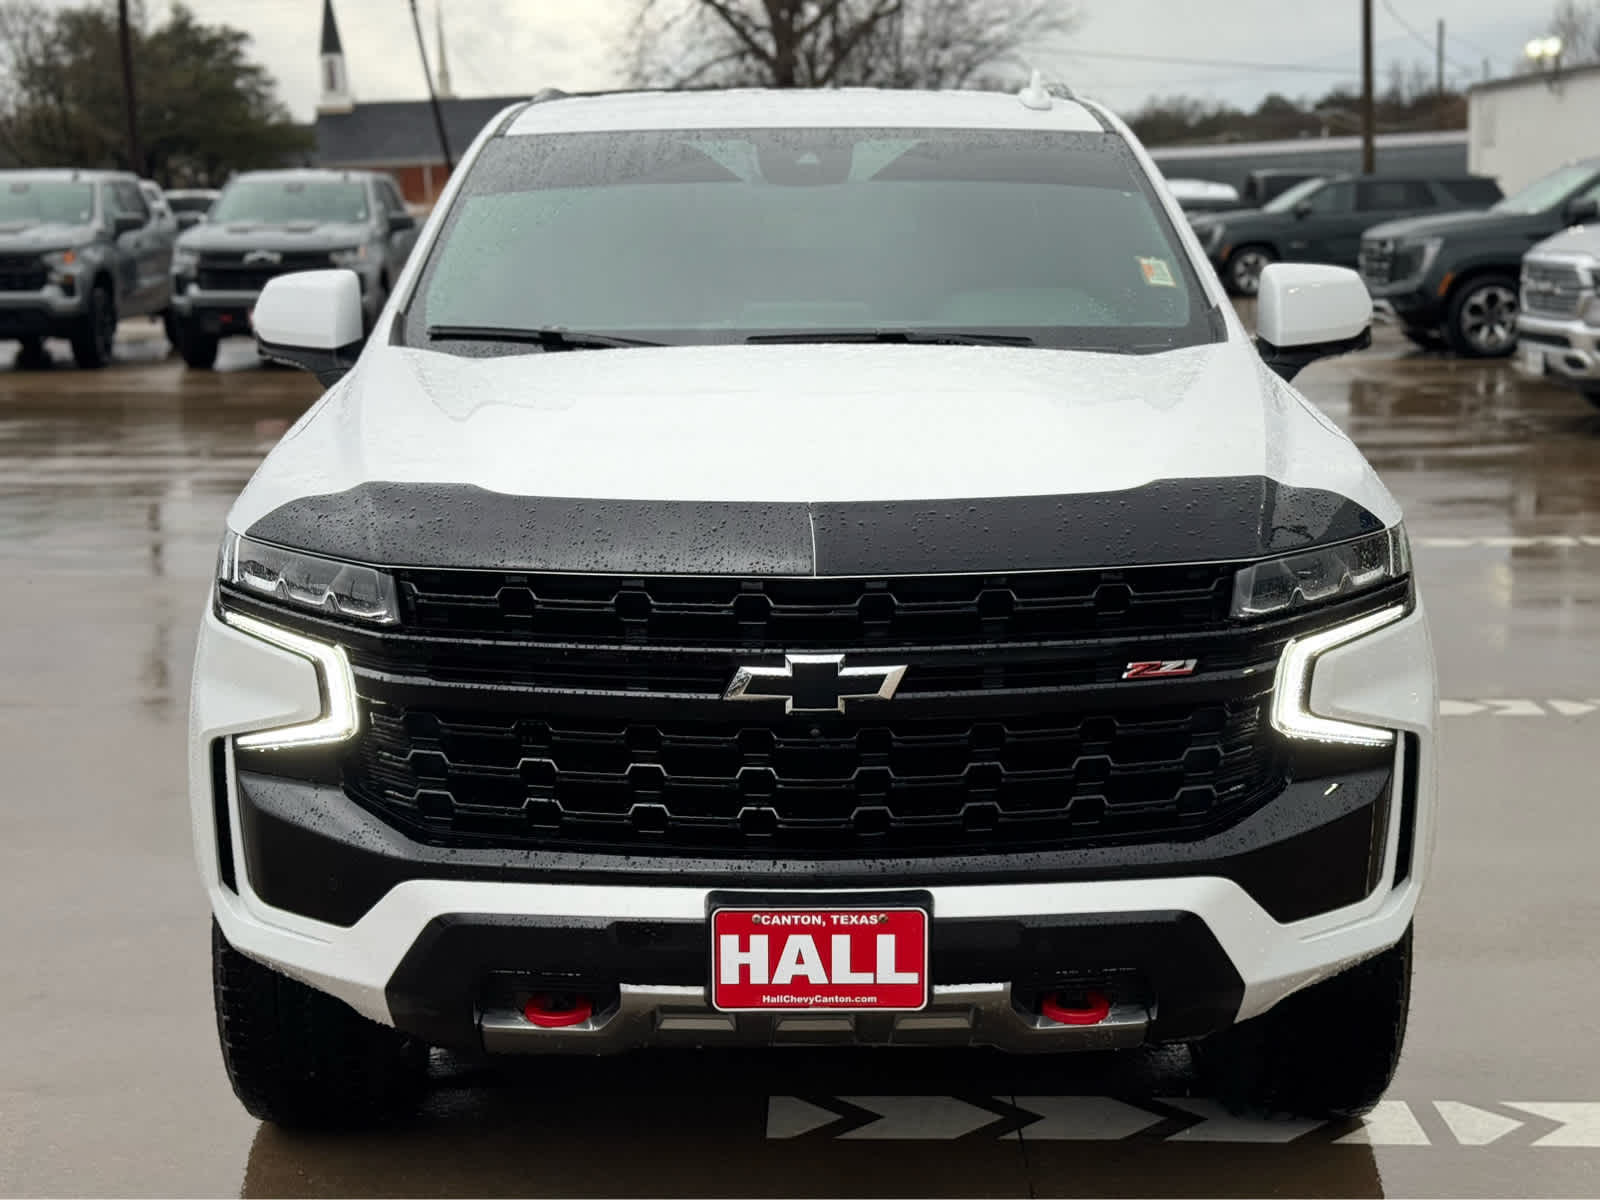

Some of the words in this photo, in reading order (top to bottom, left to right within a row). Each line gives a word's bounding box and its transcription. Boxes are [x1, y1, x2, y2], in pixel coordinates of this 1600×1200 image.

[761, 914, 826, 927] CANTON,
[830, 914, 878, 925] TEXAS
[720, 934, 919, 985] HALL
[762, 994, 878, 1005] HallChevyCanton.com
